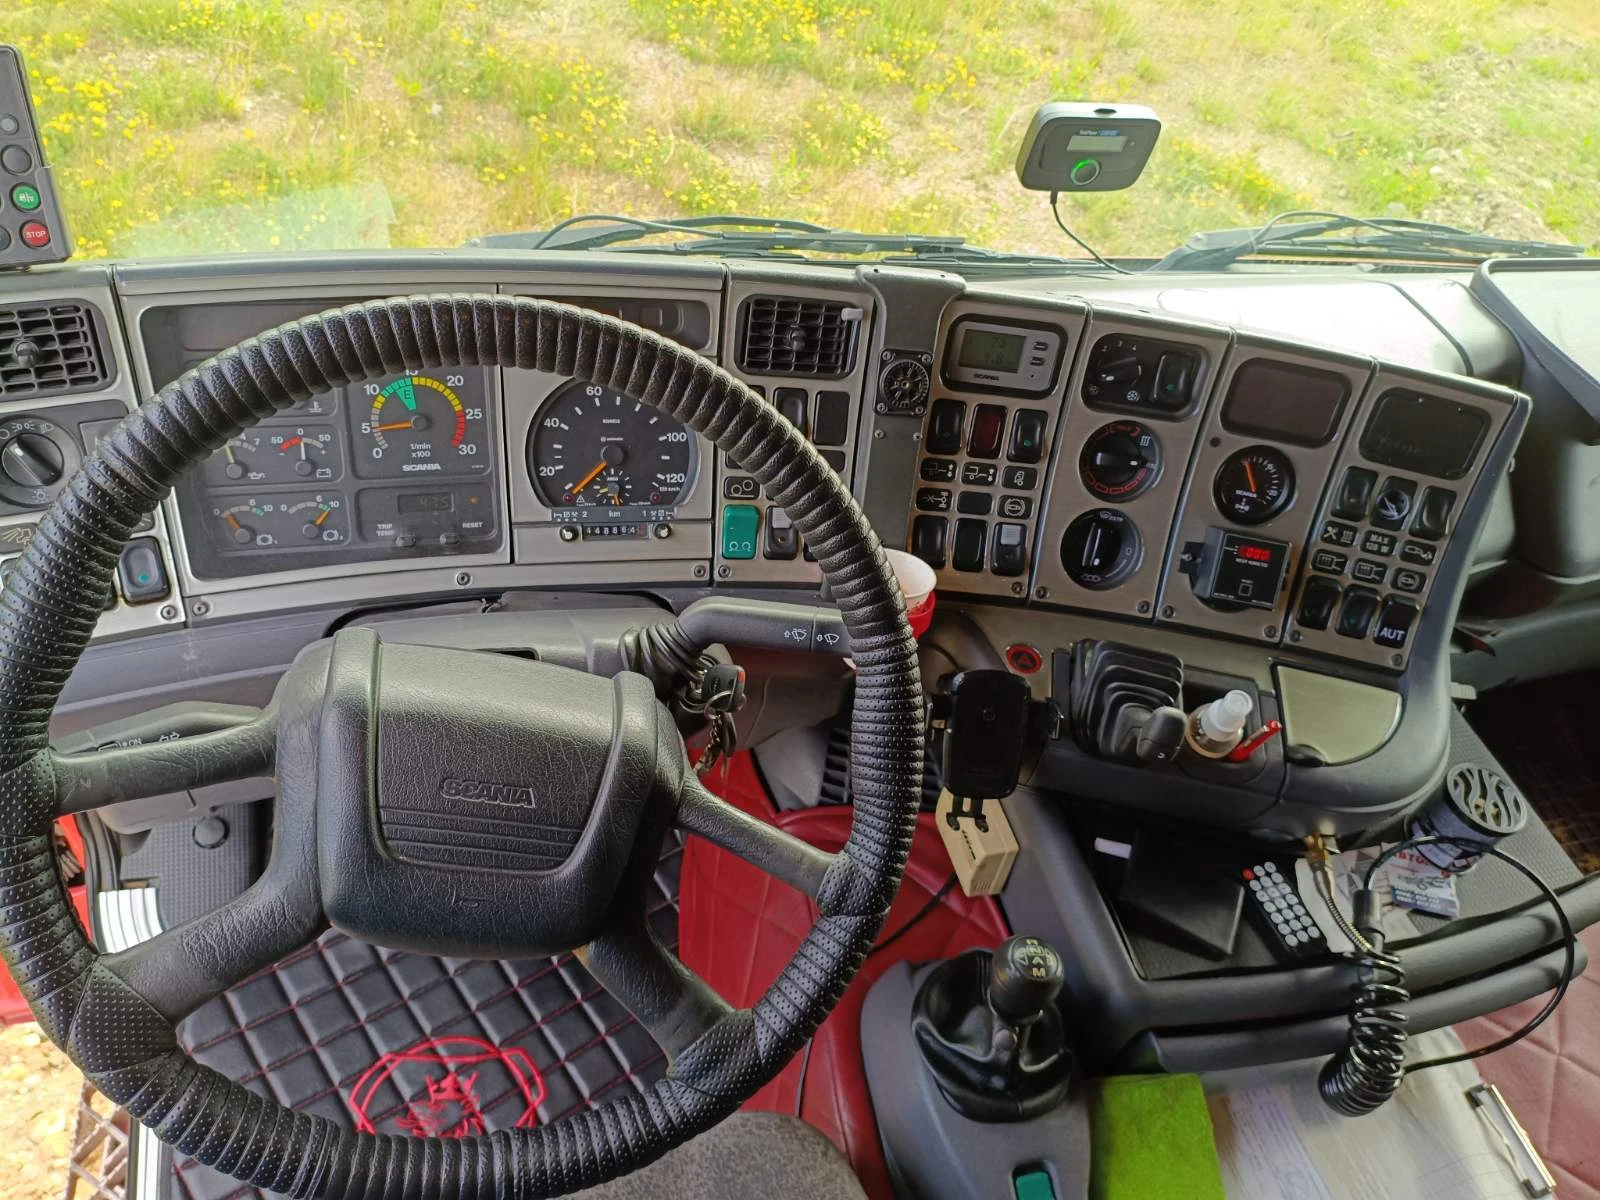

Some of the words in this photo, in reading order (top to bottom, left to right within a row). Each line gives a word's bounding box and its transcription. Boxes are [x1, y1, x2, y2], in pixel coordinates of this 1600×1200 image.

[26, 230, 46, 239] STOP
[446, 375, 464, 387] 20
[363, 383, 380, 396] 10
[586, 386, 602, 396] 60
[465, 408, 483, 420] 25
[361, 422, 371, 434] 5
[543, 417, 560, 428] 40
[297, 428, 304, 436] 0
[666, 432, 687, 442] 100
[271, 436, 284, 445] 50
[318, 434, 331, 442] 50
[372, 447, 383, 459] 0
[458, 444, 477, 455] 30
[402, 463, 441, 472] SCANIA
[539, 466, 556, 477] 20
[666, 473, 685, 483] 120
[263, 504, 273, 512] 10
[280, 503, 288, 511] 0
[462, 521, 483, 529] RESET
[1370, 532, 1391, 544] MAX
[1379, 627, 1405, 641] AUT
[442, 778, 536, 809] SCANIA
[1032, 967, 1046, 978] M
